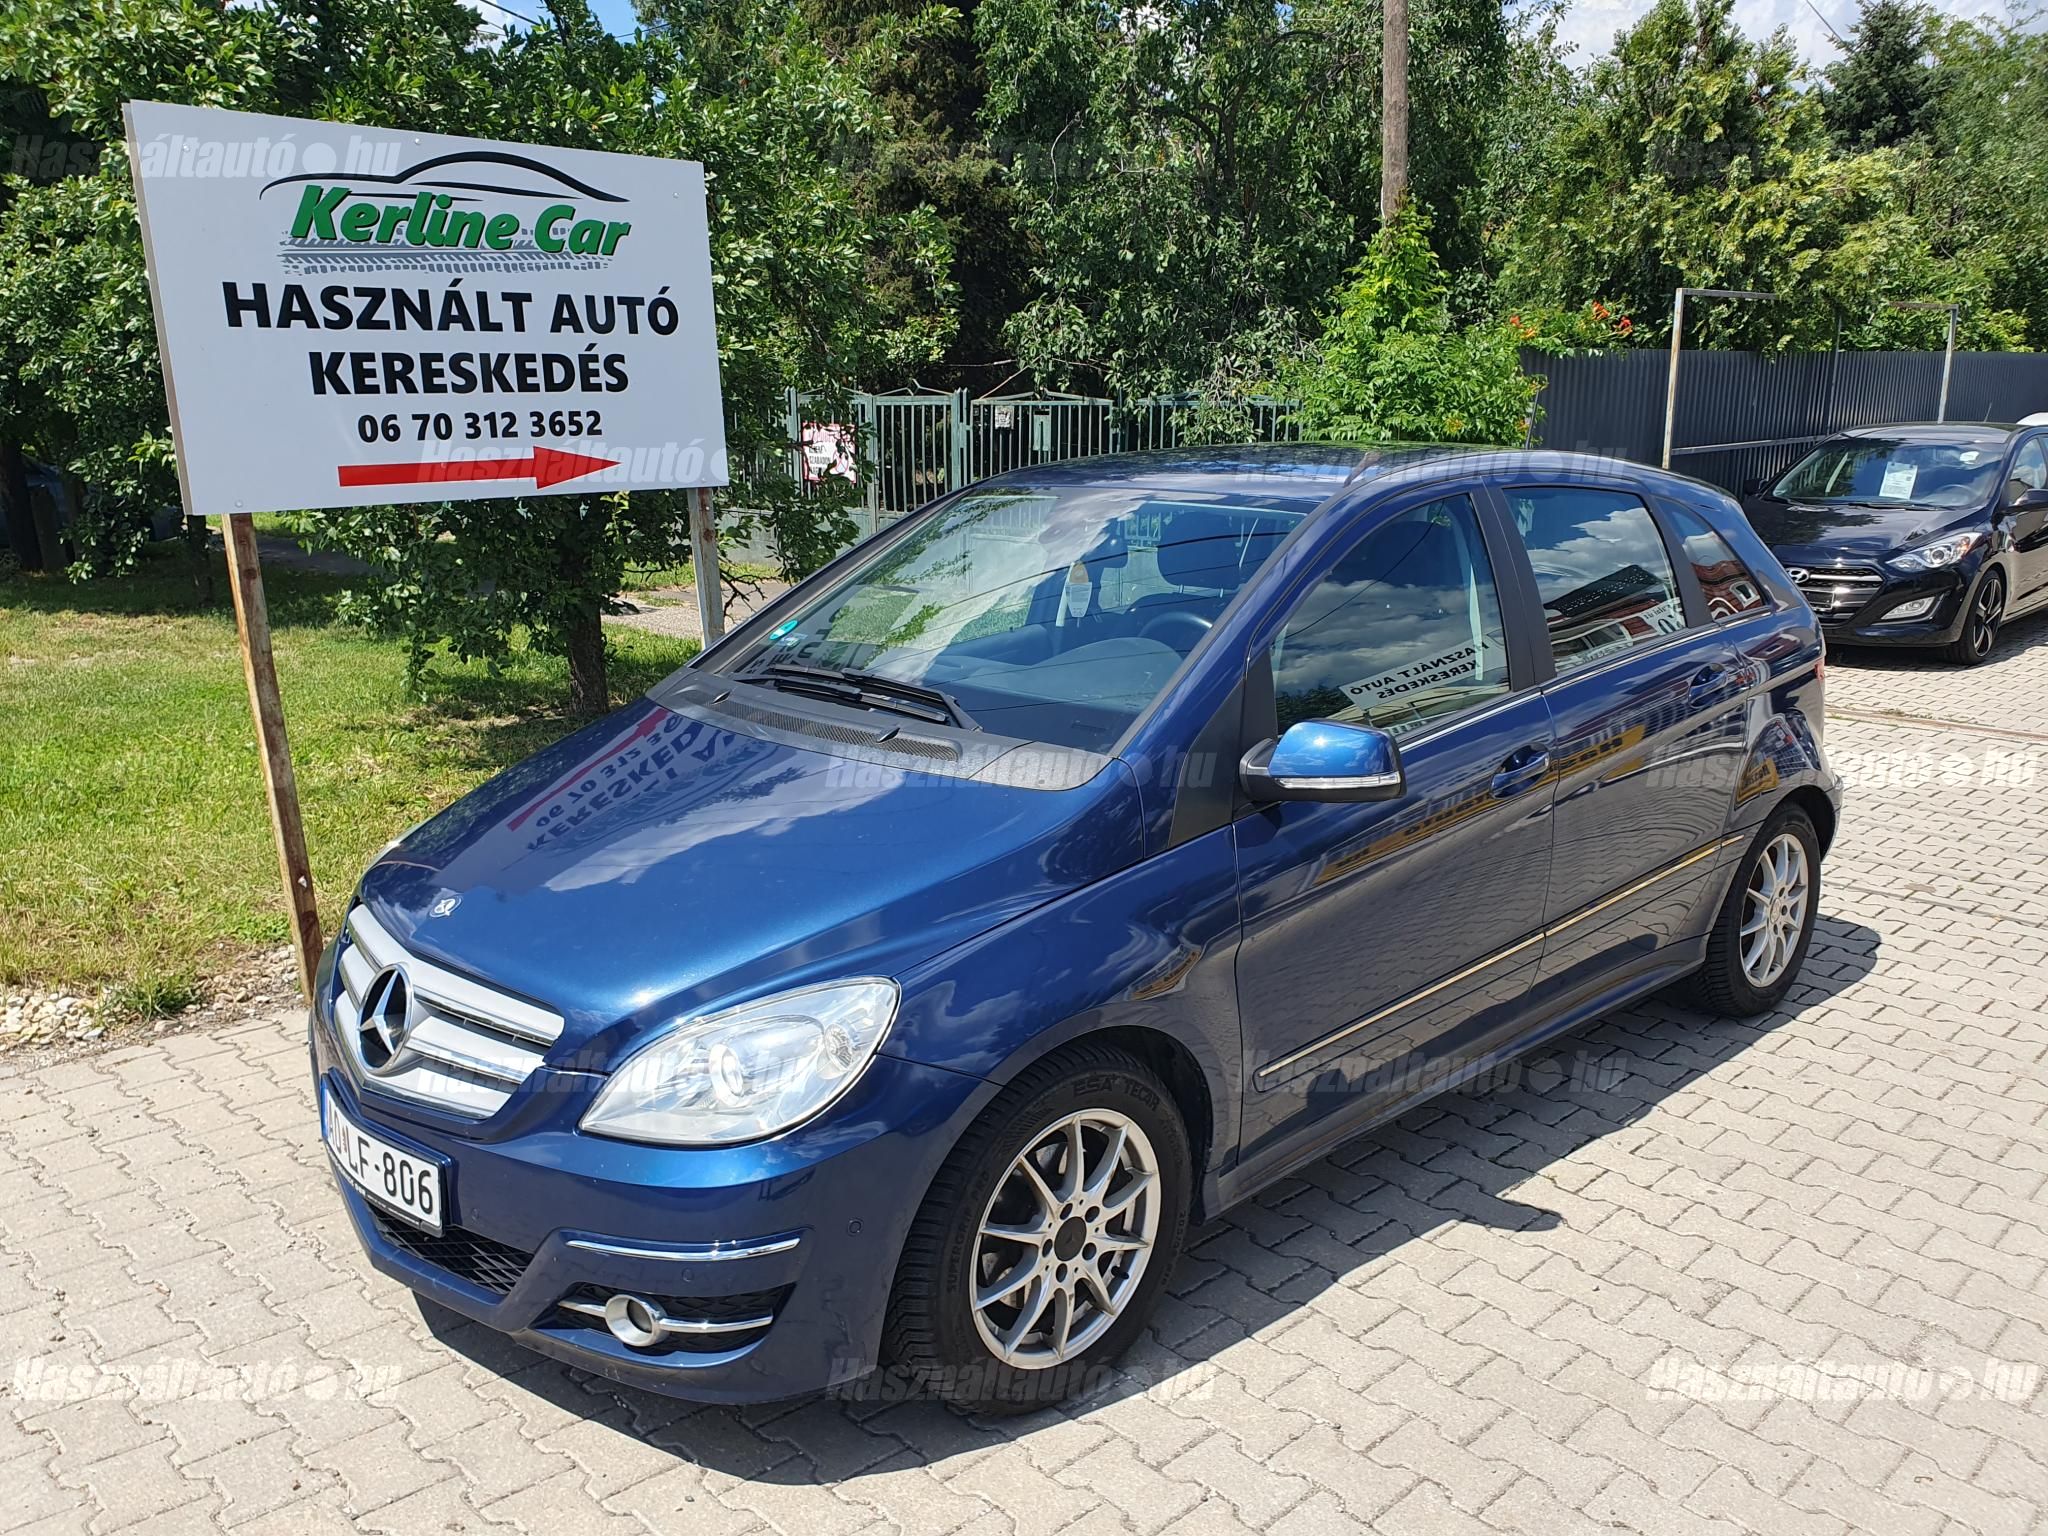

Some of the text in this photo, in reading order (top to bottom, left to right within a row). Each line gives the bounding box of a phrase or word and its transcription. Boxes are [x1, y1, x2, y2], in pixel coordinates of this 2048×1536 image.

[290, 184, 631, 256] Kerline Car
[222, 277, 680, 336] HASZNÁLT AUTÓ
[308, 342, 629, 395] KERESKEDÉS
[357, 410, 603, 443] 06 70 312 3652
